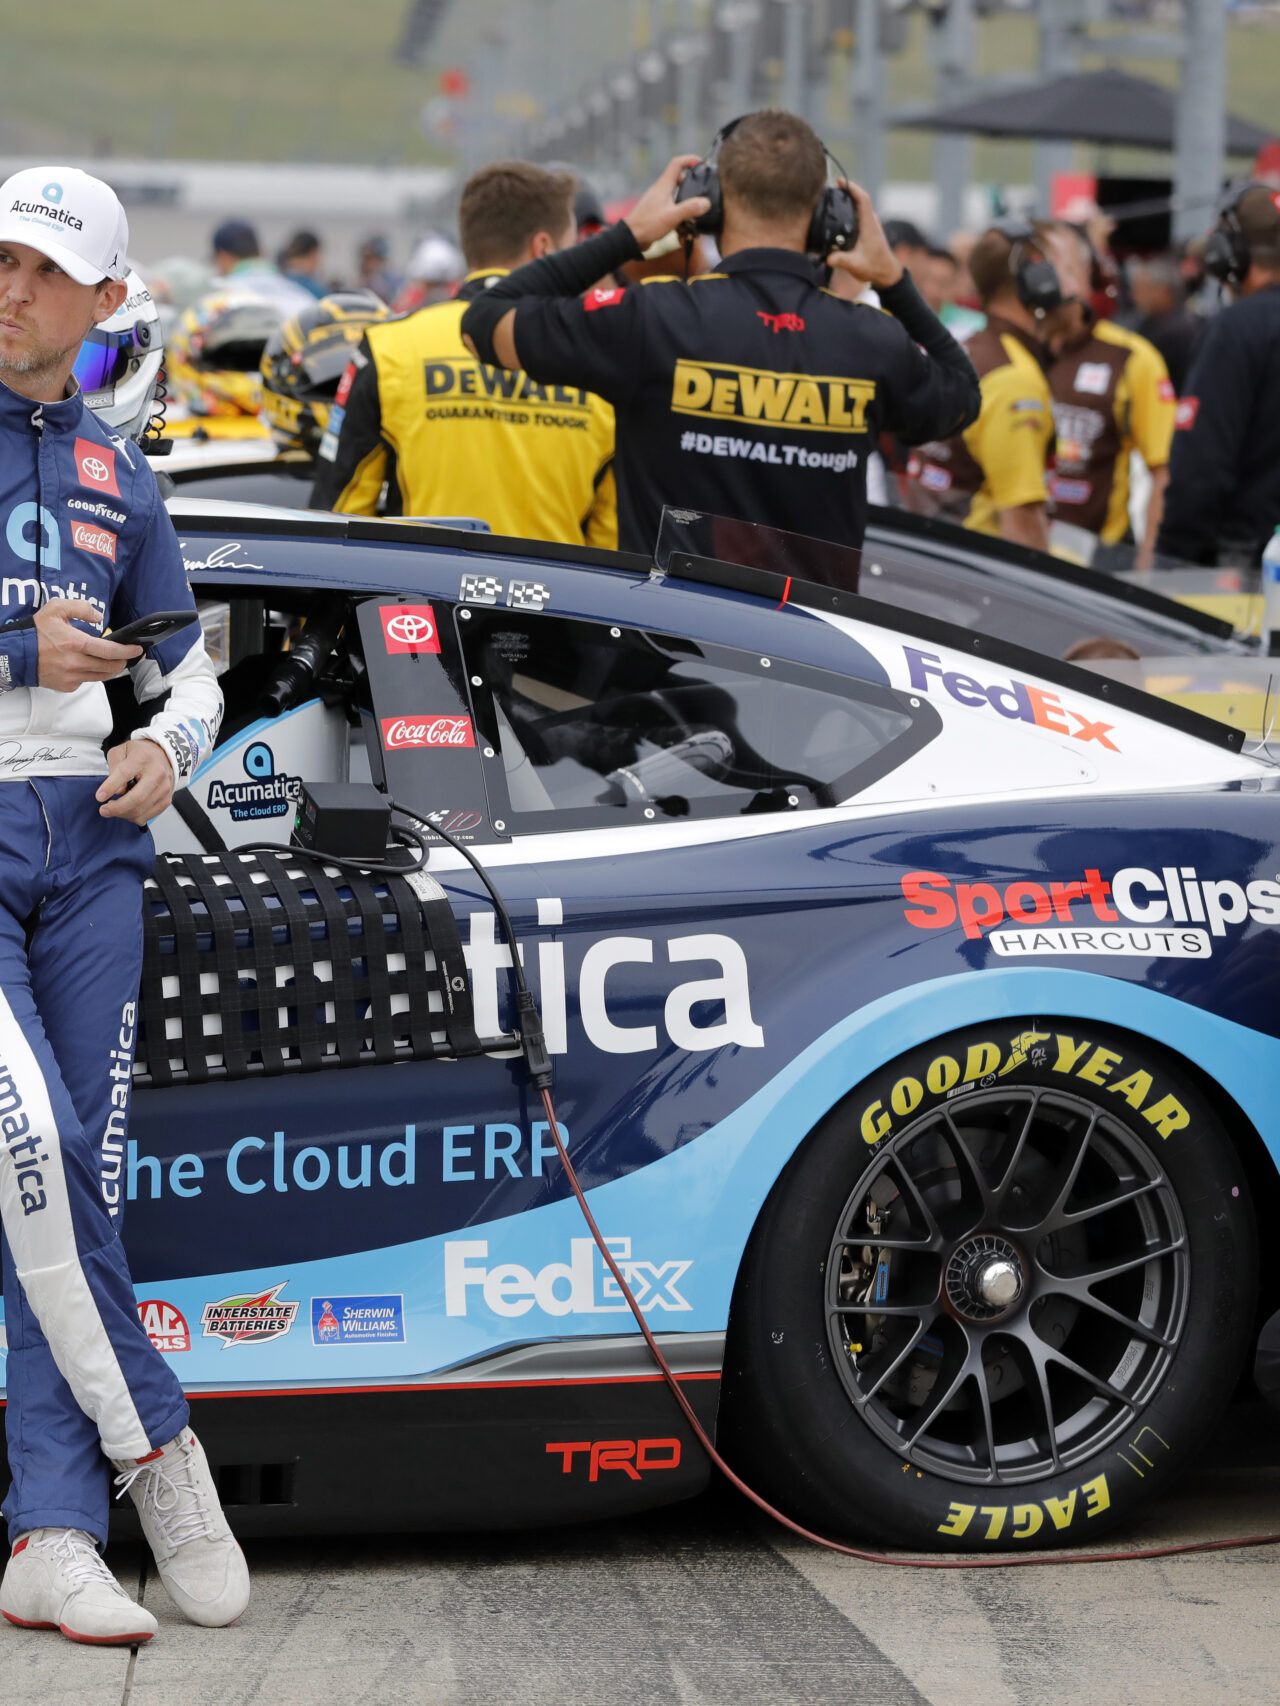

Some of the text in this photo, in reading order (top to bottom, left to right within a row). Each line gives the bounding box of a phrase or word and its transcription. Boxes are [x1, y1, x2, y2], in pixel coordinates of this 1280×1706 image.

[10, 199, 83, 231] Acumatica
[426, 405, 529, 426] GUARANTEED
[681, 431, 858, 472] #DEWALTtough
[74, 526, 115, 556] Coca-Cola
[902, 645, 1122, 754] FedEx
[386, 718, 469, 747] Coca-Cola
[210, 777, 301, 806] Acumatica
[233, 805, 287, 818] The Cloud ERP
[900, 867, 1280, 940] SportClips
[999, 932, 1202, 954] HAIRCUTS
[126, 1121, 570, 1200] he Cloud ERP
[444, 1236, 695, 1318] FedEx
[207, 1306, 293, 1319] INTERSTATE
[209, 1319, 286, 1332] BATTERIES
[342, 1307, 395, 1320] SHERWIN
[342, 1319, 397, 1332] WILLIAMS
[545, 1437, 682, 1482] TRD
[937, 1472, 1112, 1541] EAGLE
